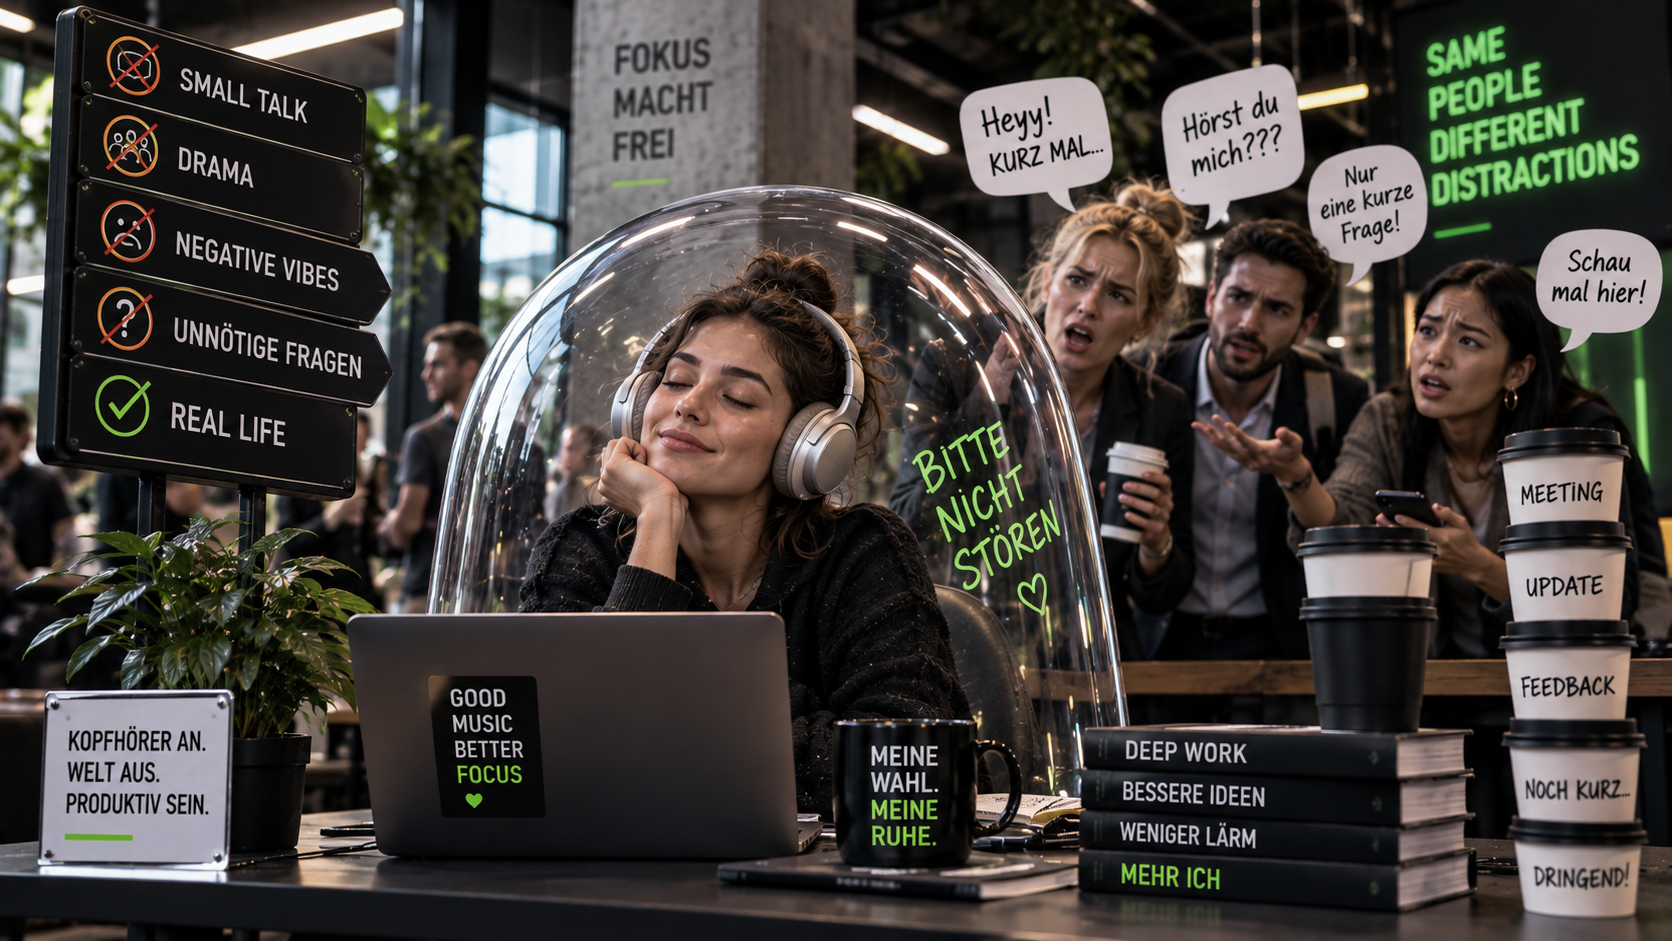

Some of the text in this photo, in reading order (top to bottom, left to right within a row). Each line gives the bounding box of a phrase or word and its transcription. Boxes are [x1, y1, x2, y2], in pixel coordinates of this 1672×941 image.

[615, 37, 711, 75] FOKUS
[1426, 25, 1506, 77] SAME
[180, 68, 307, 123] SMALL TALK
[614, 80, 714, 119] MACHT
[1428, 61, 1542, 121] PEOPLE
[981, 95, 1053, 141] Heyy!
[1183, 91, 1279, 143] Hörst du
[613, 128, 674, 161] FREI
[1430, 98, 1585, 164] DIFFERENT
[990, 135, 1103, 176] KURZ MAL...
[1191, 124, 1282, 176] mich???
[179, 147, 253, 188] DRAMA
[1345, 166, 1378, 187] Nur
[1431, 133, 1640, 207] DISTRACTIONS
[1321, 184, 1414, 219] eine kurze
[1341, 209, 1400, 245] Frage!
[176, 231, 338, 291] NEGATIVE VIBES
[1568, 249, 1631, 272] Schau
[1552, 279, 1646, 304] mal hier!
[175, 317, 361, 378] UNNÖTIGE FRAGEN
[171, 402, 285, 446] REAL LIFE
[954, 499, 1061, 591] STÖREN
[1527, 575, 1603, 596] UPDATE
[450, 689, 505, 707] GOOD
[1521, 676, 1615, 697] FEEDBACK
[453, 715, 512, 732] MUSIC
[69, 726, 205, 751] KOPFHÖRER AN.
[455, 741, 523, 758] BETTER
[1126, 740, 1177, 761] DEEP
[1185, 742, 1247, 763] WORK
[871, 746, 938, 766] MEINE
[68, 762, 159, 783] WELT AUS.
[457, 765, 522, 783] FOCUS
[871, 772, 938, 793] WAHL.
[1123, 781, 1203, 804] BESSERE
[1210, 785, 1265, 807] IDEEN
[1526, 779, 1630, 800] NOCH KURZ...
[66, 793, 208, 814] PRODUKTIV SEIN.
[871, 799, 938, 820] MEINE
[872, 826, 936, 846] RUHE.
[1120, 822, 1199, 845] WENIGER
[1207, 823, 1256, 848] LÄRM
[1122, 863, 1179, 887] MEHR
[1187, 867, 1220, 890] ICH
[1534, 862, 1630, 890] DRINGEND!
